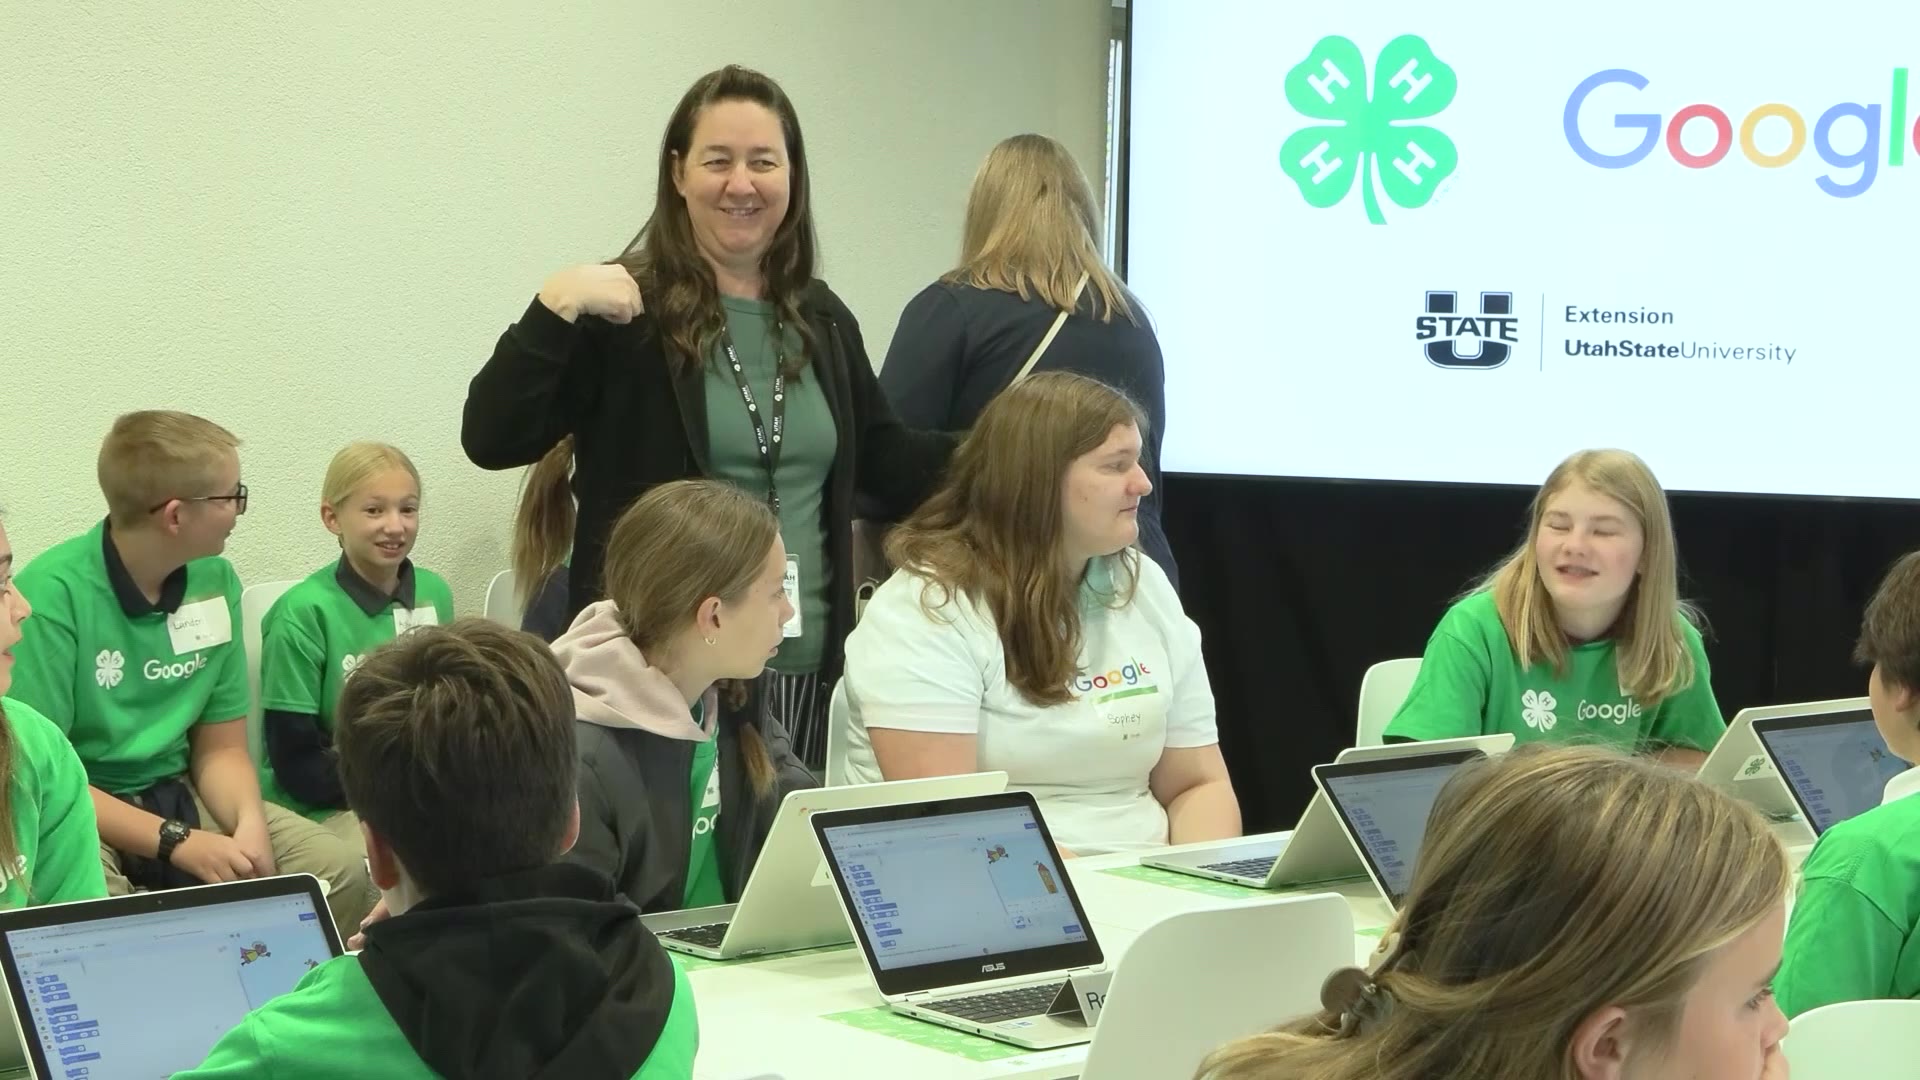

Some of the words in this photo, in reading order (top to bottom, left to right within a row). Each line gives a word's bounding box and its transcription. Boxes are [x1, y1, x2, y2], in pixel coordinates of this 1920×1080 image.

[1563, 68, 1920, 199] Googl
[1565, 305, 1674, 324] Extension
[1416, 316, 1519, 343] STATE
[1564, 339, 1797, 365] UtahStateUniversity
[144, 653, 207, 680] Google
[1075, 656, 1151, 692] Google
[1107, 713, 1141, 728] Sophey
[1577, 698, 1642, 725] Google
[981, 962, 1006, 973] ASUS
